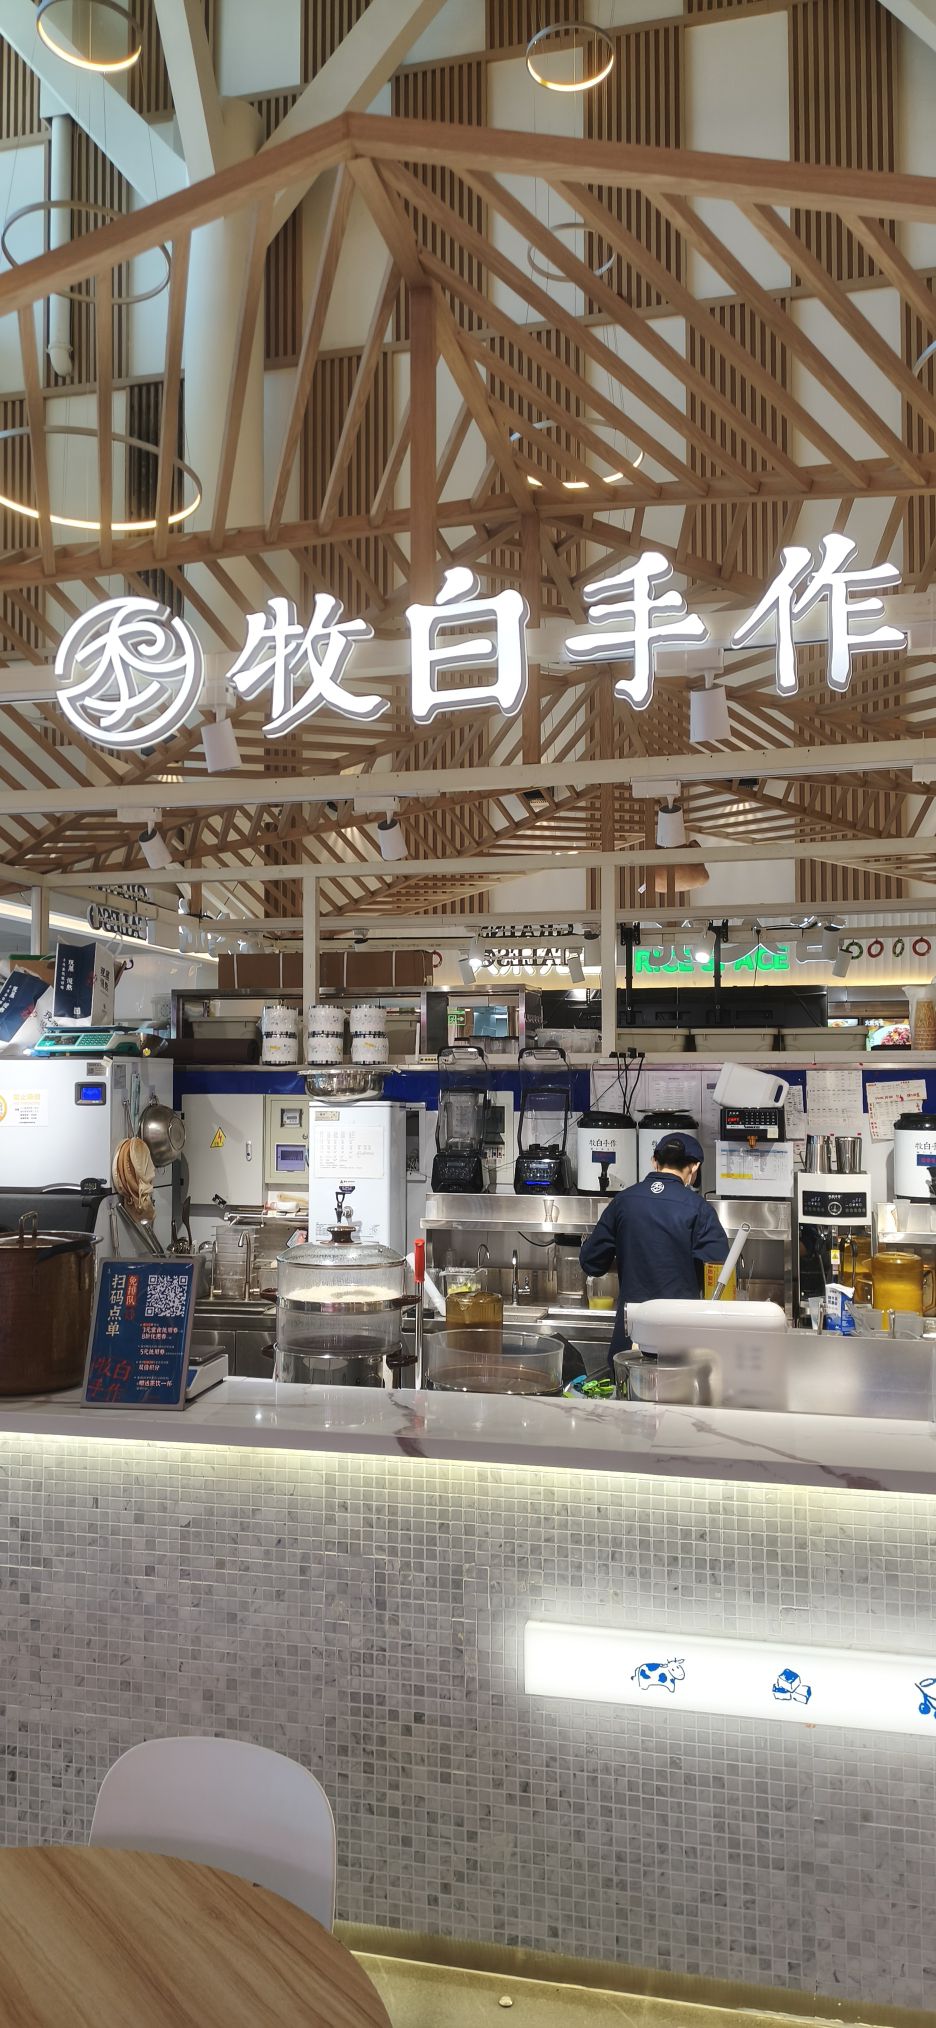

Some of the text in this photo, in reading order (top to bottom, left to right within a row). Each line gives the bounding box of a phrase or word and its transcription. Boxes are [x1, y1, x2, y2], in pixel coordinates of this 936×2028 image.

[225, 533, 908, 738] 牧白手作
[635, 944, 791, 973] RE ACE
[589, 1138, 617, 1148] 牧白手作
[106, 1274, 127, 1337] 扫码点单
[125, 1275, 138, 1306] 免排队
